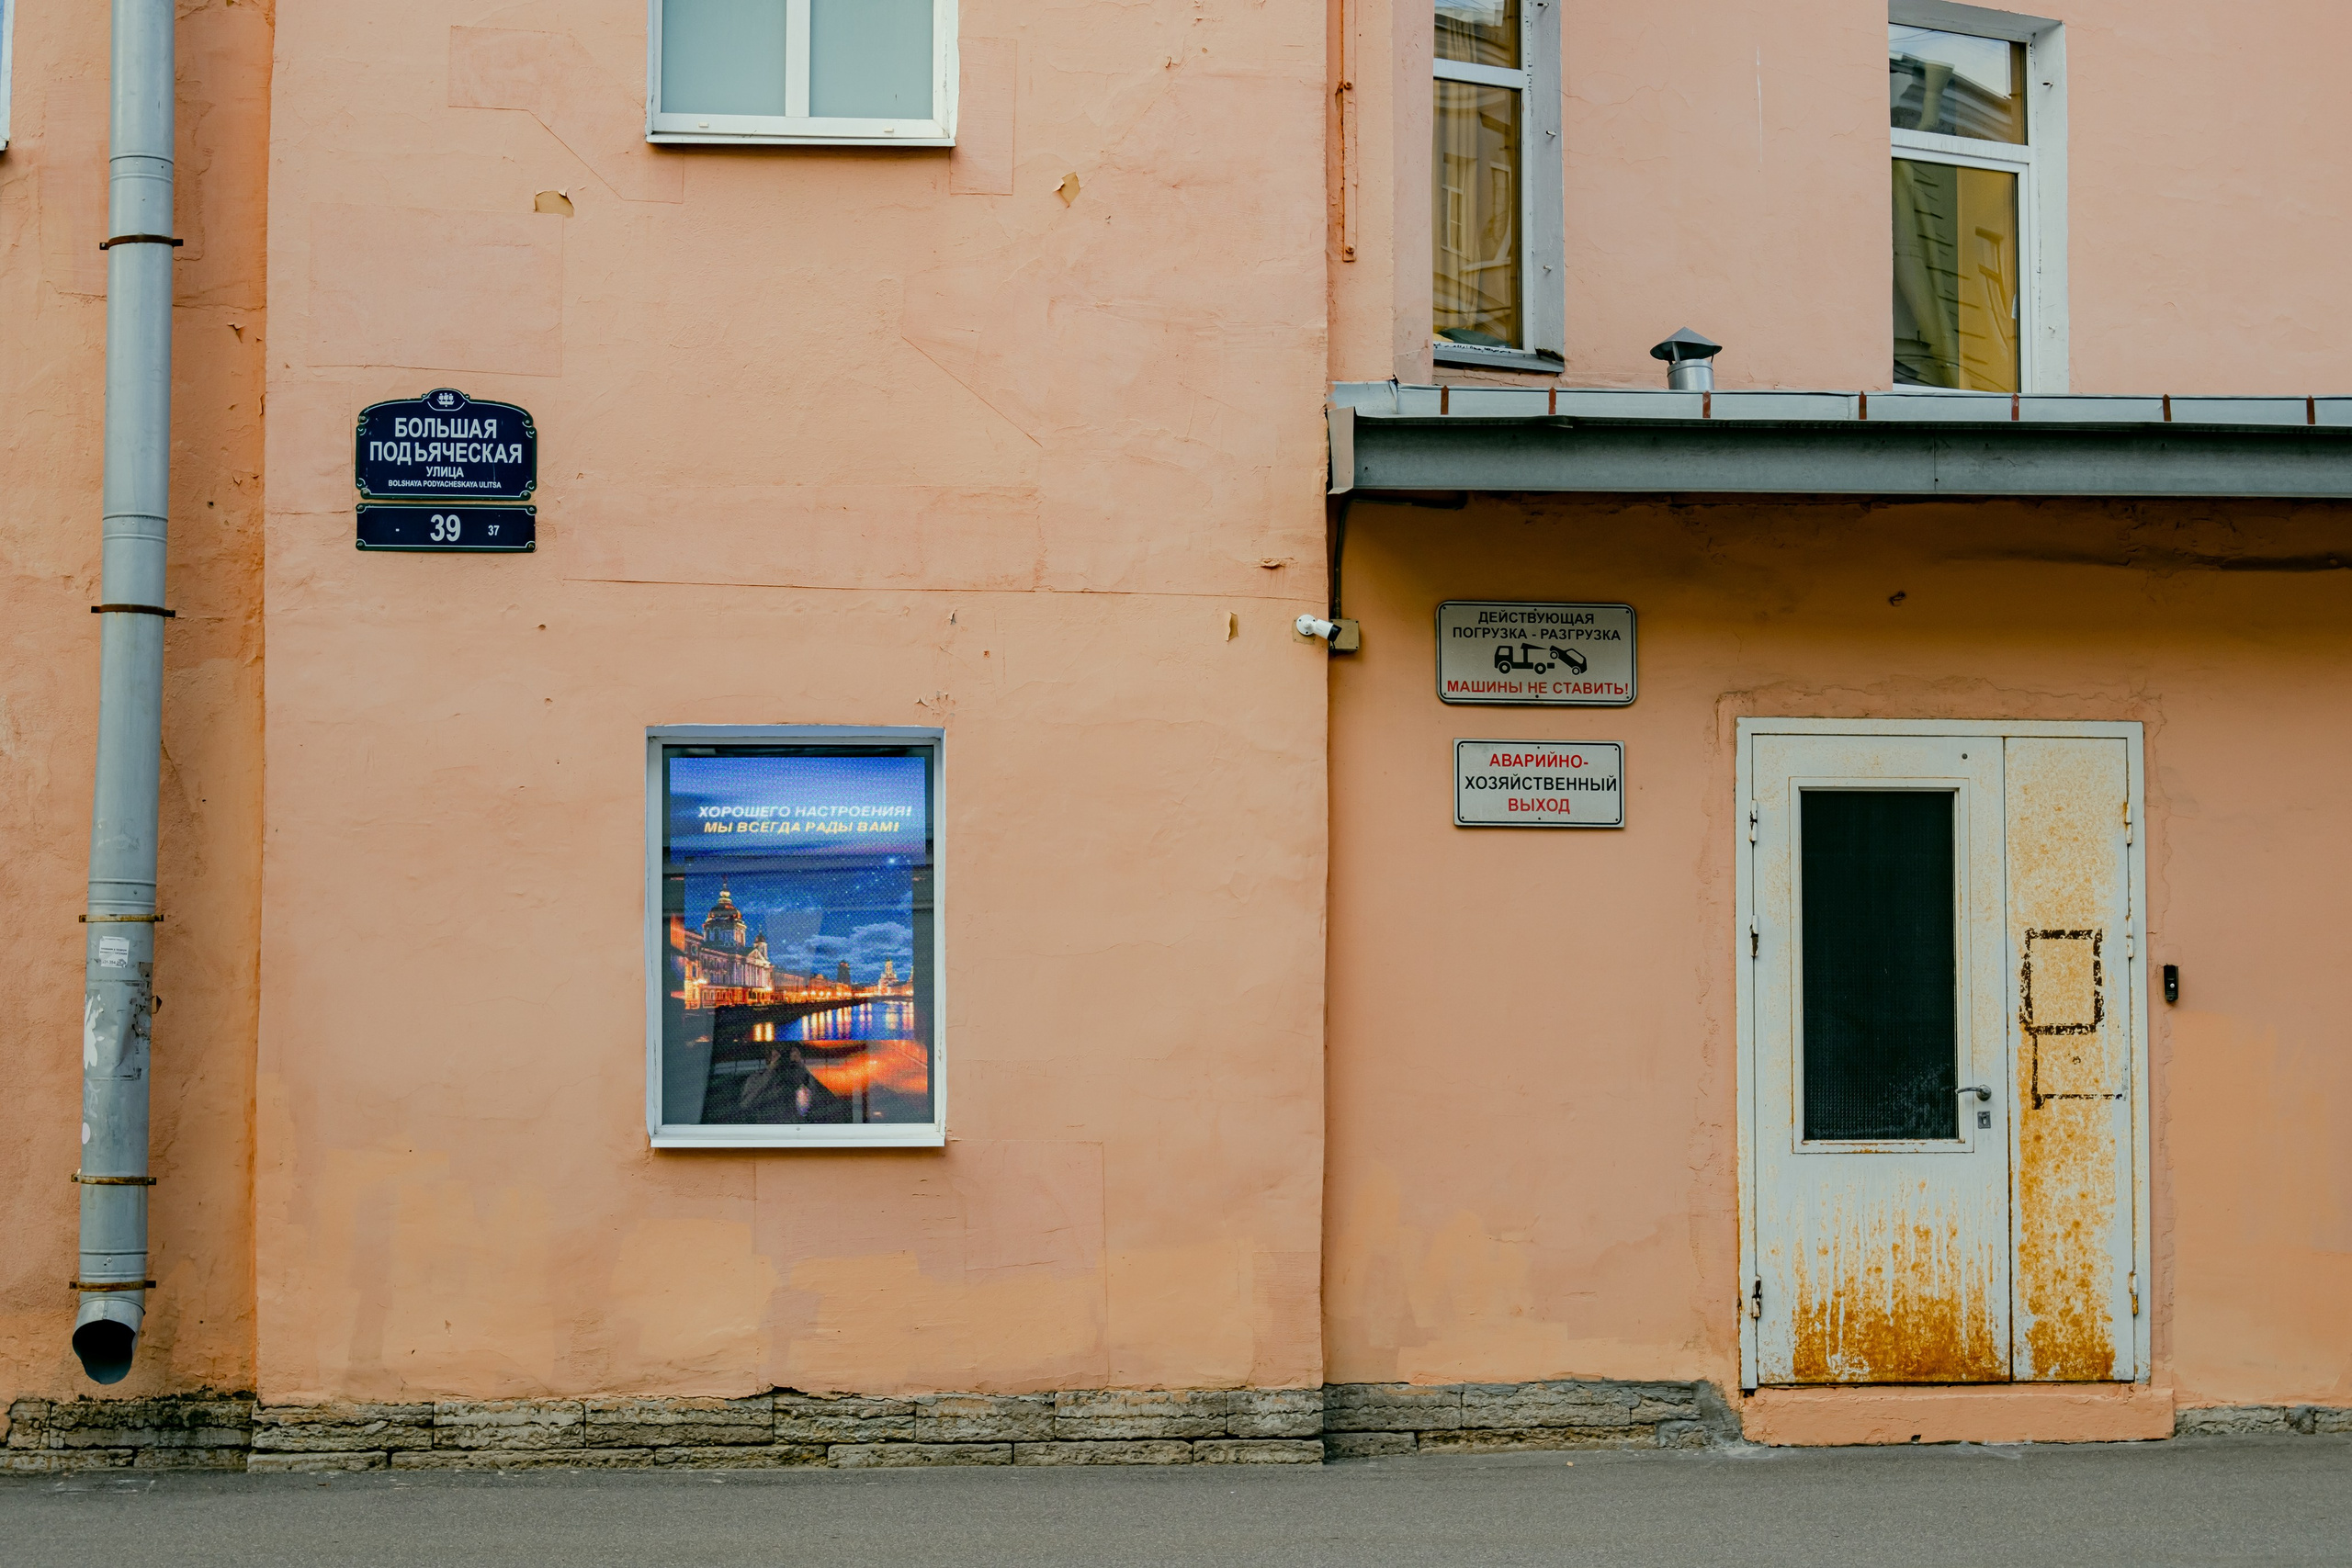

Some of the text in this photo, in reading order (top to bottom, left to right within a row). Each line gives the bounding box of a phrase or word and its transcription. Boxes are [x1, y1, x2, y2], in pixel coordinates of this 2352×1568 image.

[394, 417, 497, 439] БОЛЬШАЯ
[369, 441, 523, 466] ПОДЬЯЧЕСКАЯ
[425, 466, 464, 479] УЛИЦА
[429, 513, 461, 542] 39
[488, 525, 500, 536] 37
[1478, 610, 1594, 626] ДЕЙСТВУЮЩАЯ
[1453, 627, 1527, 639] ПОГРУЗКА
[1541, 629, 1621, 641] РАЗГРУЗКА
[1447, 681, 1629, 694] МАШИНЫ НЕ СТАВИТЬ!
[1489, 751, 1589, 768] АВАРИЙНО-
[1465, 773, 1616, 791] ХОЗЯЙСТВЕННЫЙ
[698, 806, 912, 818] ХОРОШЕГО НАСТРОЕНИЯ!
[1508, 798, 1570, 814] ВЫХОД
[705, 821, 899, 834] МЫ ВСЕГДА РАДЫ ВАМ!
